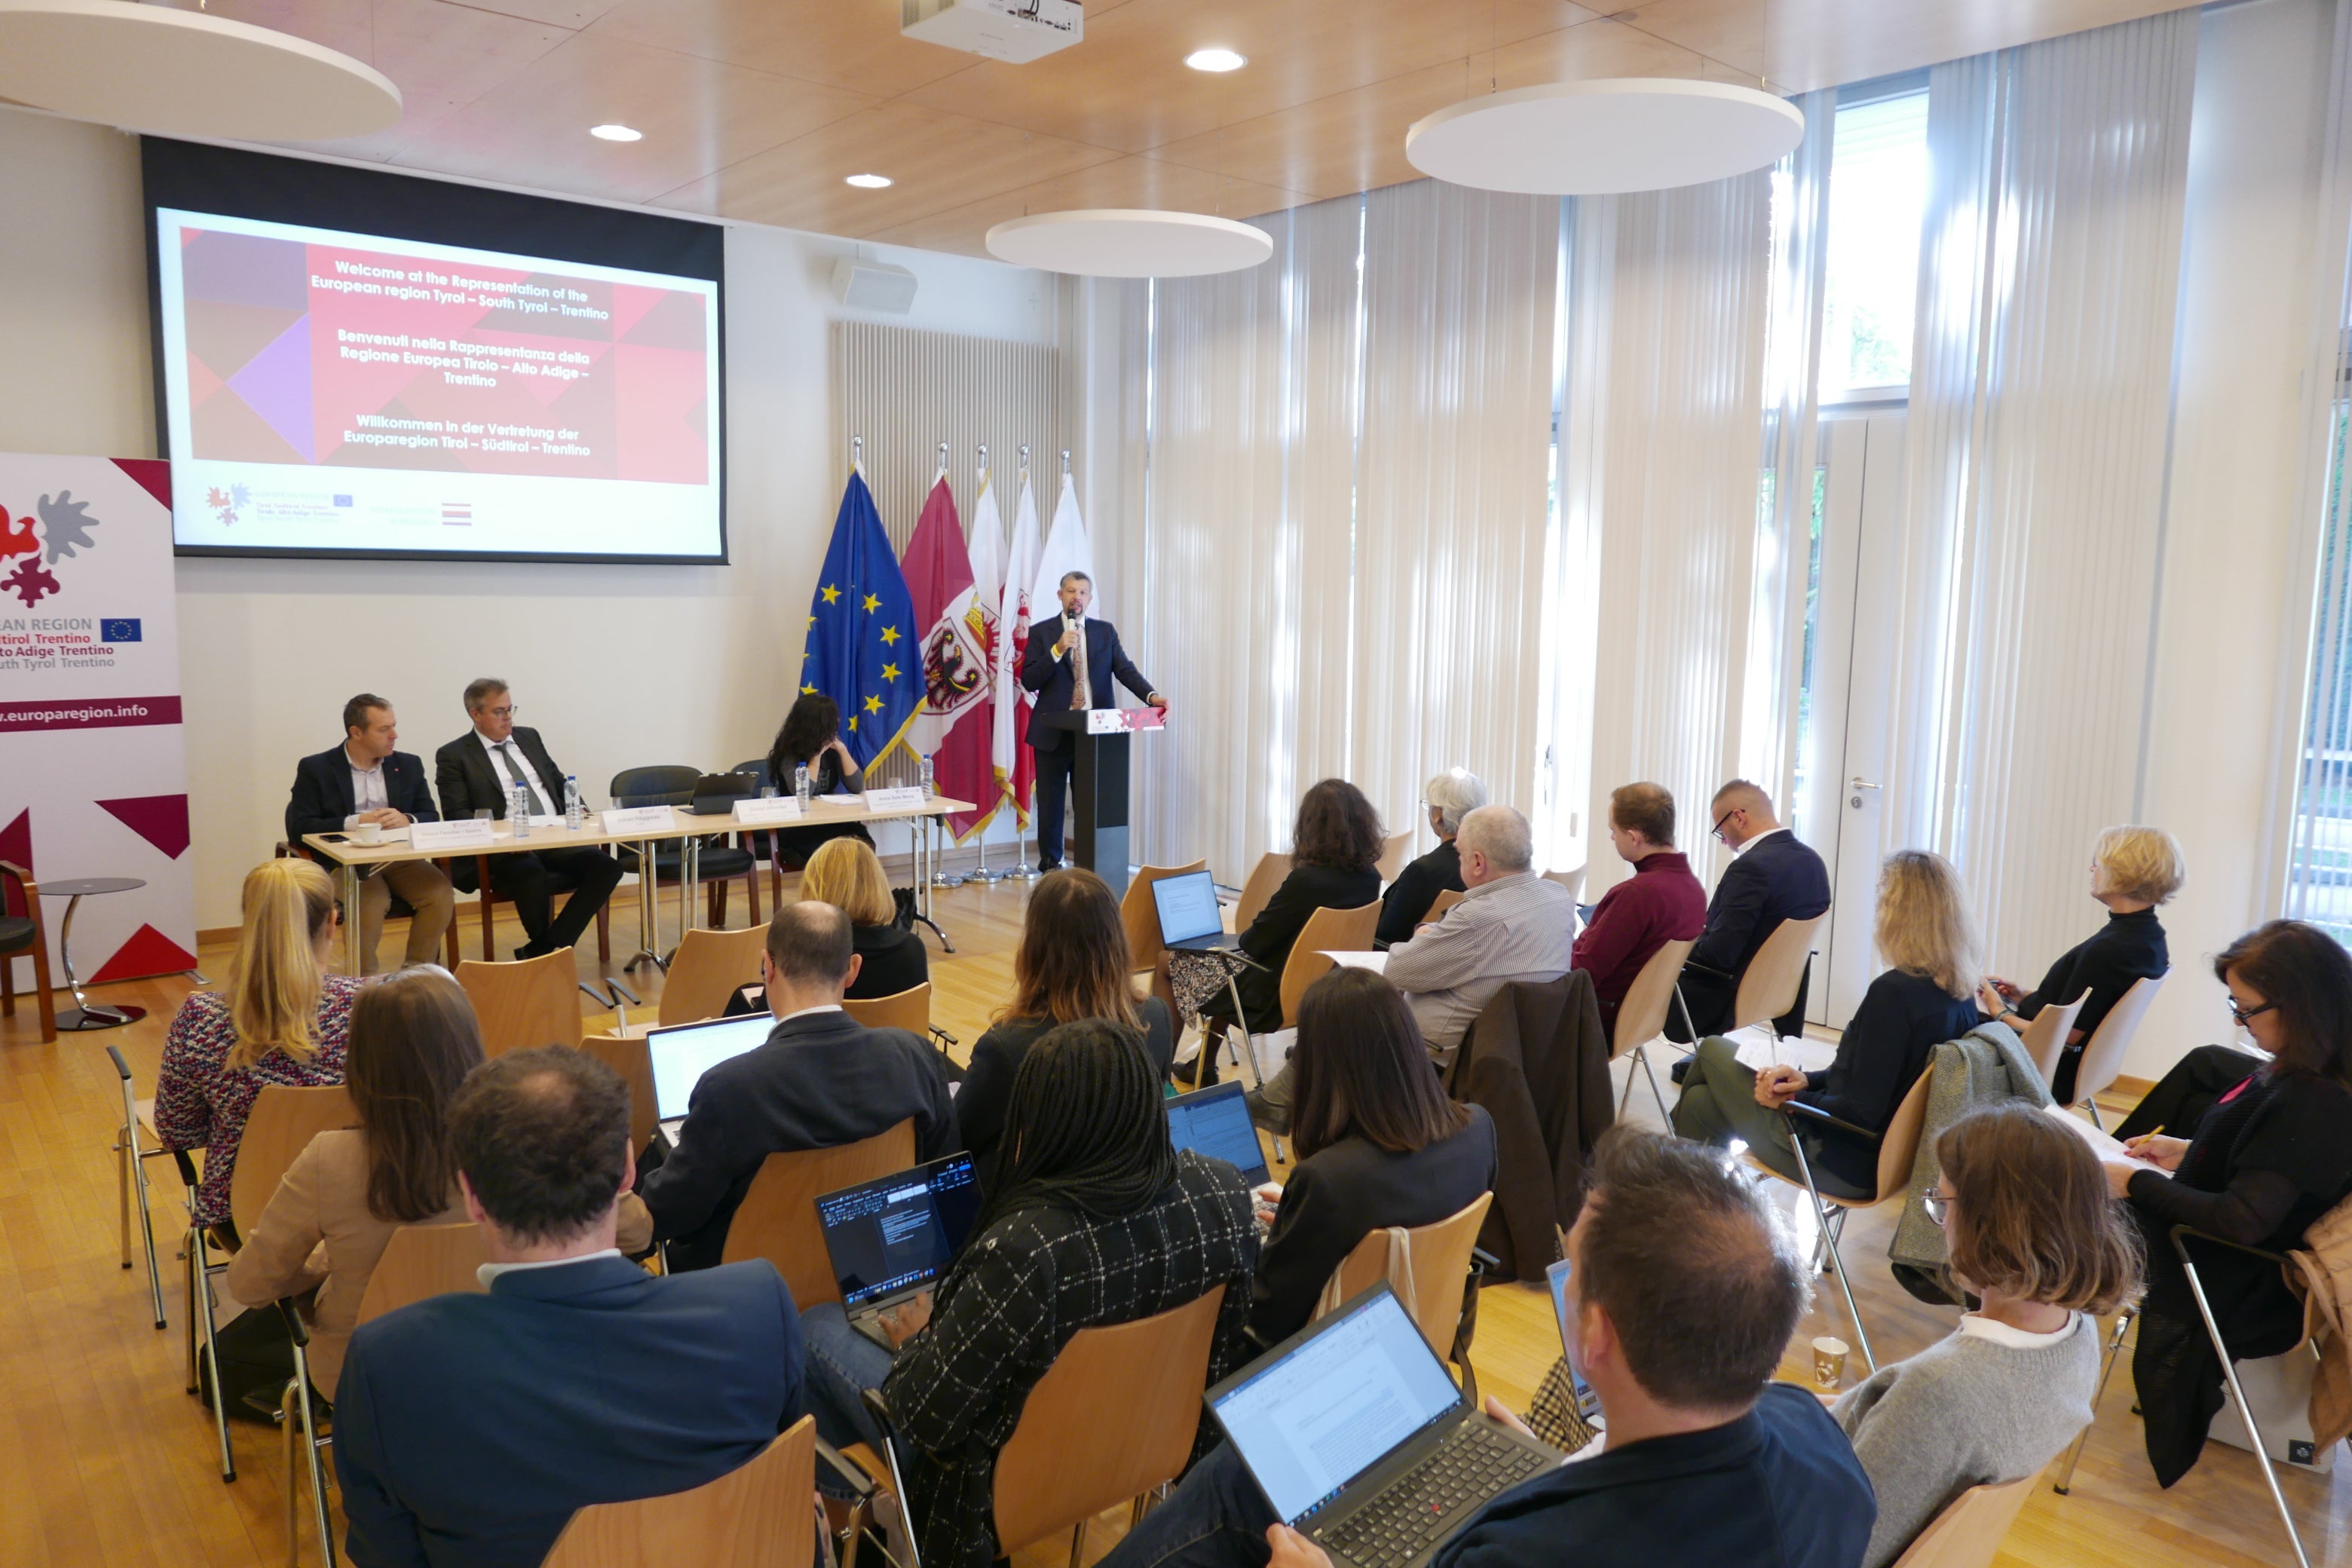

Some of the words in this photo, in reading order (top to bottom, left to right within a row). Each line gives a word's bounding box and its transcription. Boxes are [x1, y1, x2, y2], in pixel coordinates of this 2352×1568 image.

[335, 260, 405, 280] Welcome
[408, 270, 423, 283] at
[426, 271, 448, 286] the
[452, 275, 550, 299] Representation
[553, 288, 565, 301] of
[568, 289, 588, 302] the
[311, 275, 381, 296] European
[385, 284, 430, 302] region
[433, 289, 464, 307] Tyrol
[479, 294, 515, 310] South
[518, 299, 547, 314] Tyrol
[561, 304, 608, 320] Trentino
[338, 329, 409, 348] Benvenuti
[412, 337, 446, 351] nella
[449, 340, 556, 363] Rappresentanza
[559, 349, 590, 364] della
[341, 346, 399, 364] Regione
[403, 352, 460, 369] Europea
[463, 357, 498, 371] Tirolo
[513, 362, 537, 375] Alto
[541, 365, 578, 379] Adige
[444, 372, 496, 387] Trentino
[357, 415, 443, 433] Willkommen
[446, 421, 458, 433] in
[461, 421, 485, 434] der
[488, 424, 554, 440] Vertretung
[558, 427, 579, 440] der
[344, 430, 438, 449] Europaregion
[442, 436, 467, 449] Tirol
[482, 437, 528, 453] Südtirol
[543, 442, 590, 456] Trentino
[0, 619, 26, 630] AN
[32, 618, 92, 630] REGION
[0, 634, 29, 645] tirol
[35, 634, 90, 644] Trentino
[16, 646, 54, 659] Adige
[59, 645, 114, 656] Trentino
[23, 658, 55, 671] Tyrol
[61, 657, 115, 667] Trentino
